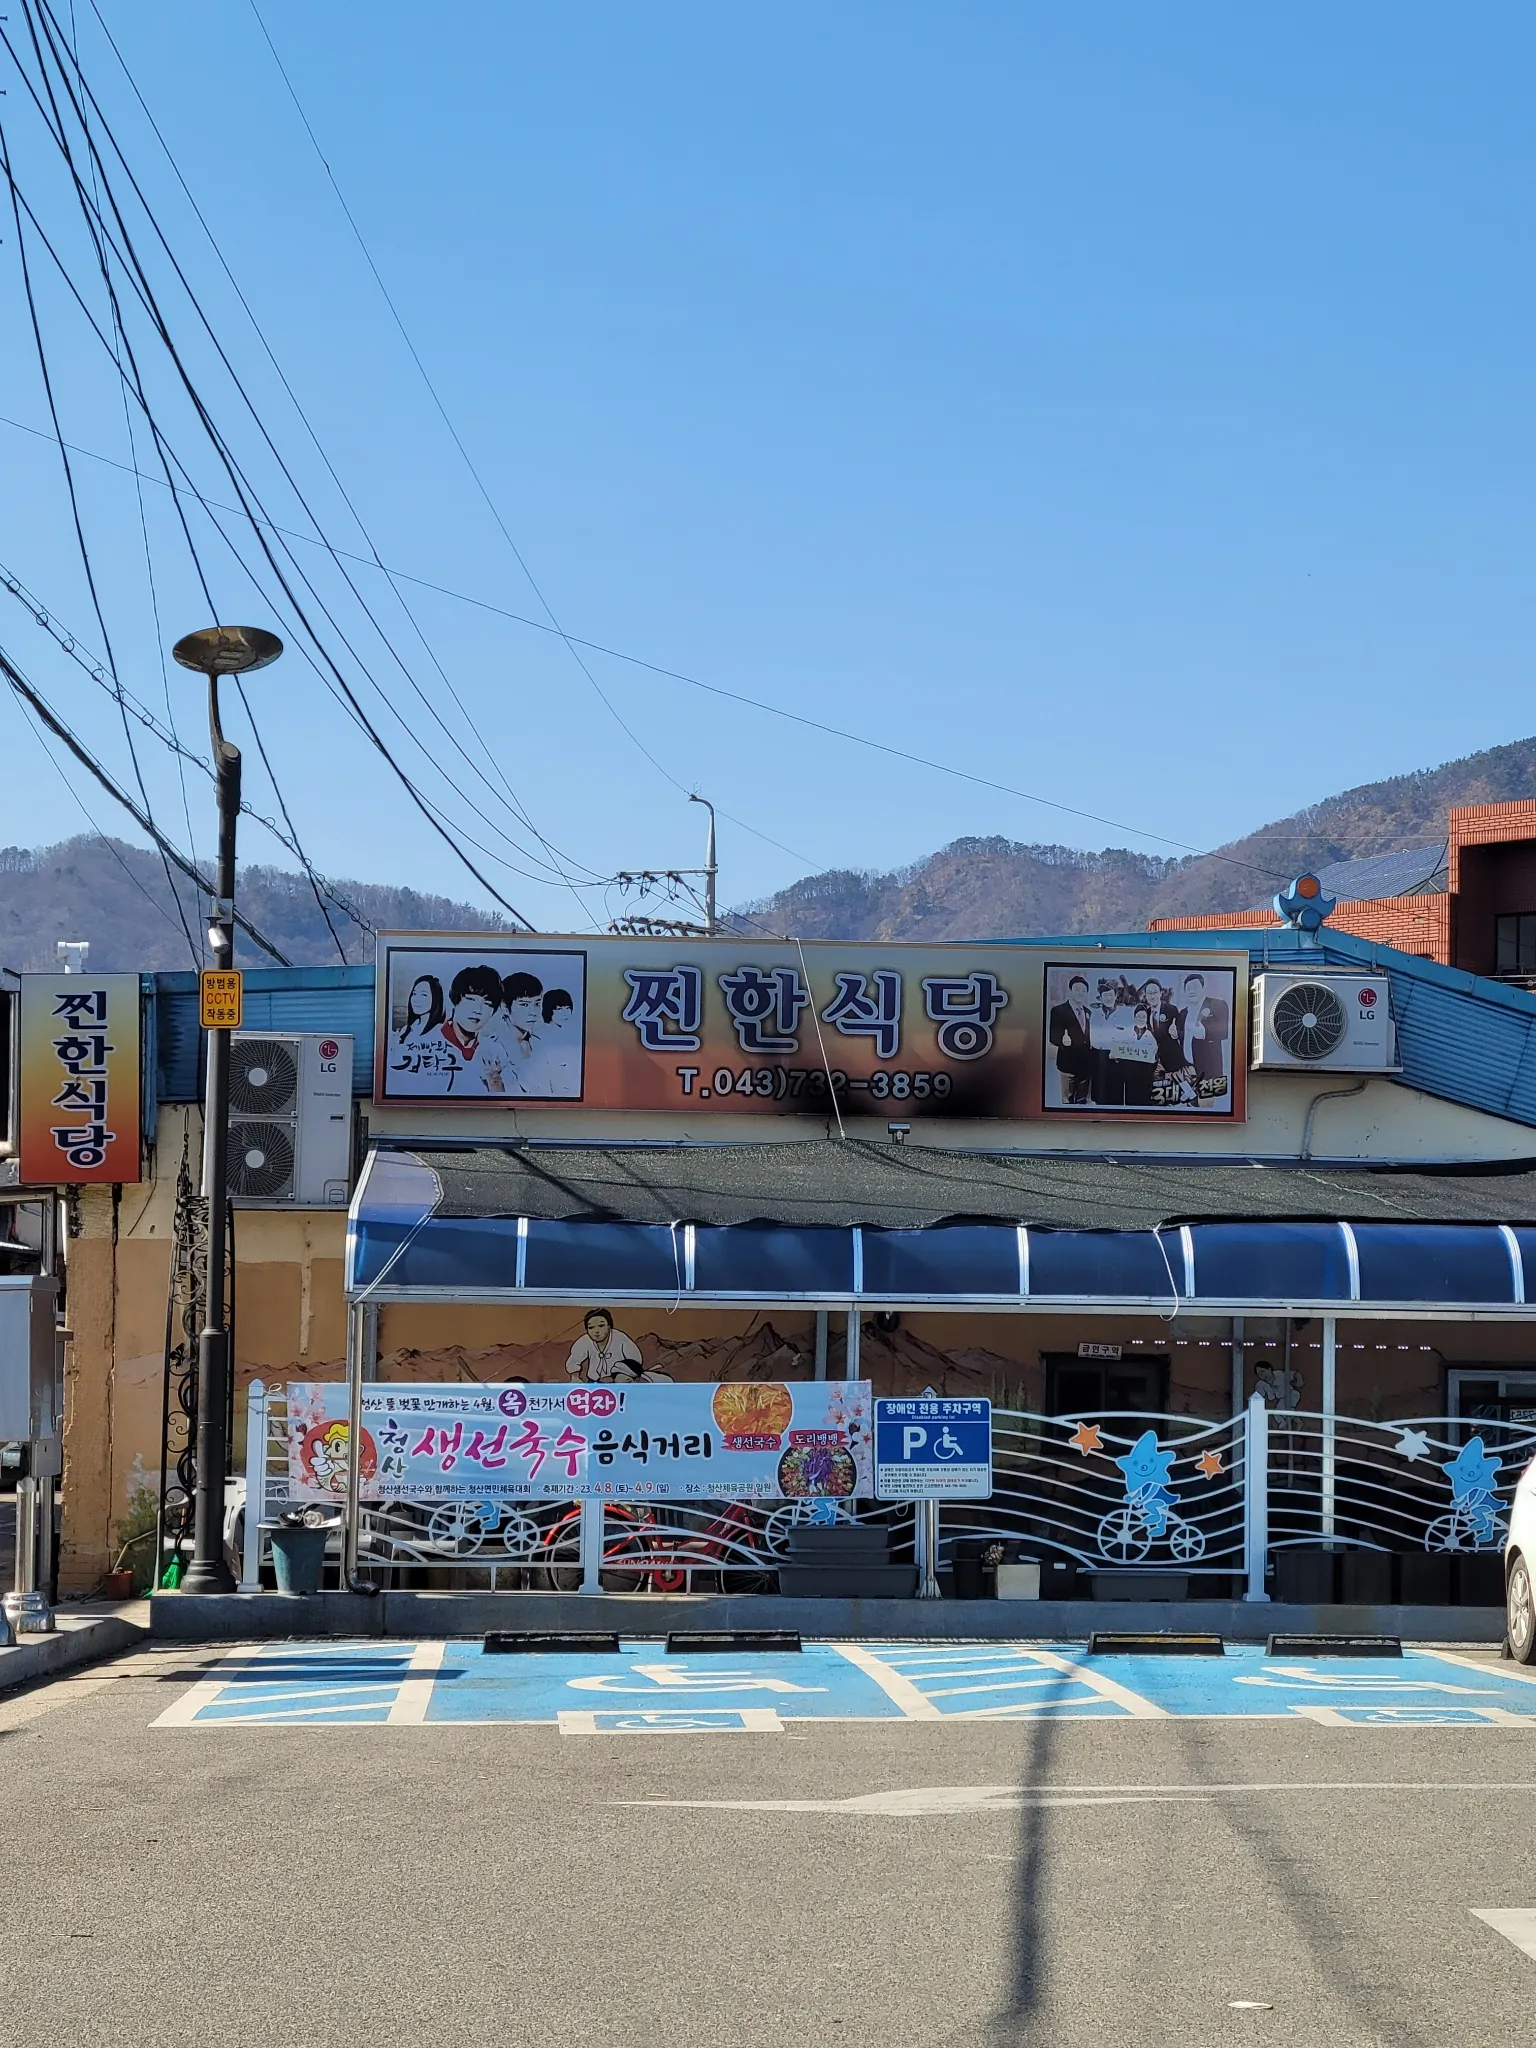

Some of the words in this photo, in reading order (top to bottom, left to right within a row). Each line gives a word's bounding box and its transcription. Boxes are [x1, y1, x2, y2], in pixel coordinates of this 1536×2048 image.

[206, 977, 236, 989] 방범용
[206, 992, 236, 1005] CCTV
[206, 1008, 236, 1020] 작동중
[623, 965, 1008, 1060] 찐한식당
[1360, 1010, 1375, 1020] LG
[406, 1041, 453, 1054] 제빵왕
[320, 1062, 337, 1073] LG
[390, 1053, 463, 1093] 김탁구
[50, 990, 115, 1167] 찐한식당
[1082, 1344, 1119, 1355] 금연구역
[398, 1397, 422, 1411] 벚꽃
[424, 1397, 469, 1411] 만개하는
[473, 1397, 496, 1412] 4월,
[886, 1403, 915, 1415] 장애인
[919, 1403, 938, 1415] 전용
[942, 1403, 981, 1415] 주차구역
[732, 1436, 777, 1450] 생선국수
[794, 1432, 838, 1446] 도리뱅뱅
[903, 1426, 928, 1460] P
[379, 1419, 408, 1479] 청산
[411, 1420, 587, 1480] 생선국수
[592, 1429, 712, 1465] 음식거리
[377, 1484, 432, 1495] 청산생선국수와
[435, 1484, 466, 1495] 함께하는
[468, 1484, 531, 1495] 청산면민체육대회
[756, 1483, 771, 1494] 일원
